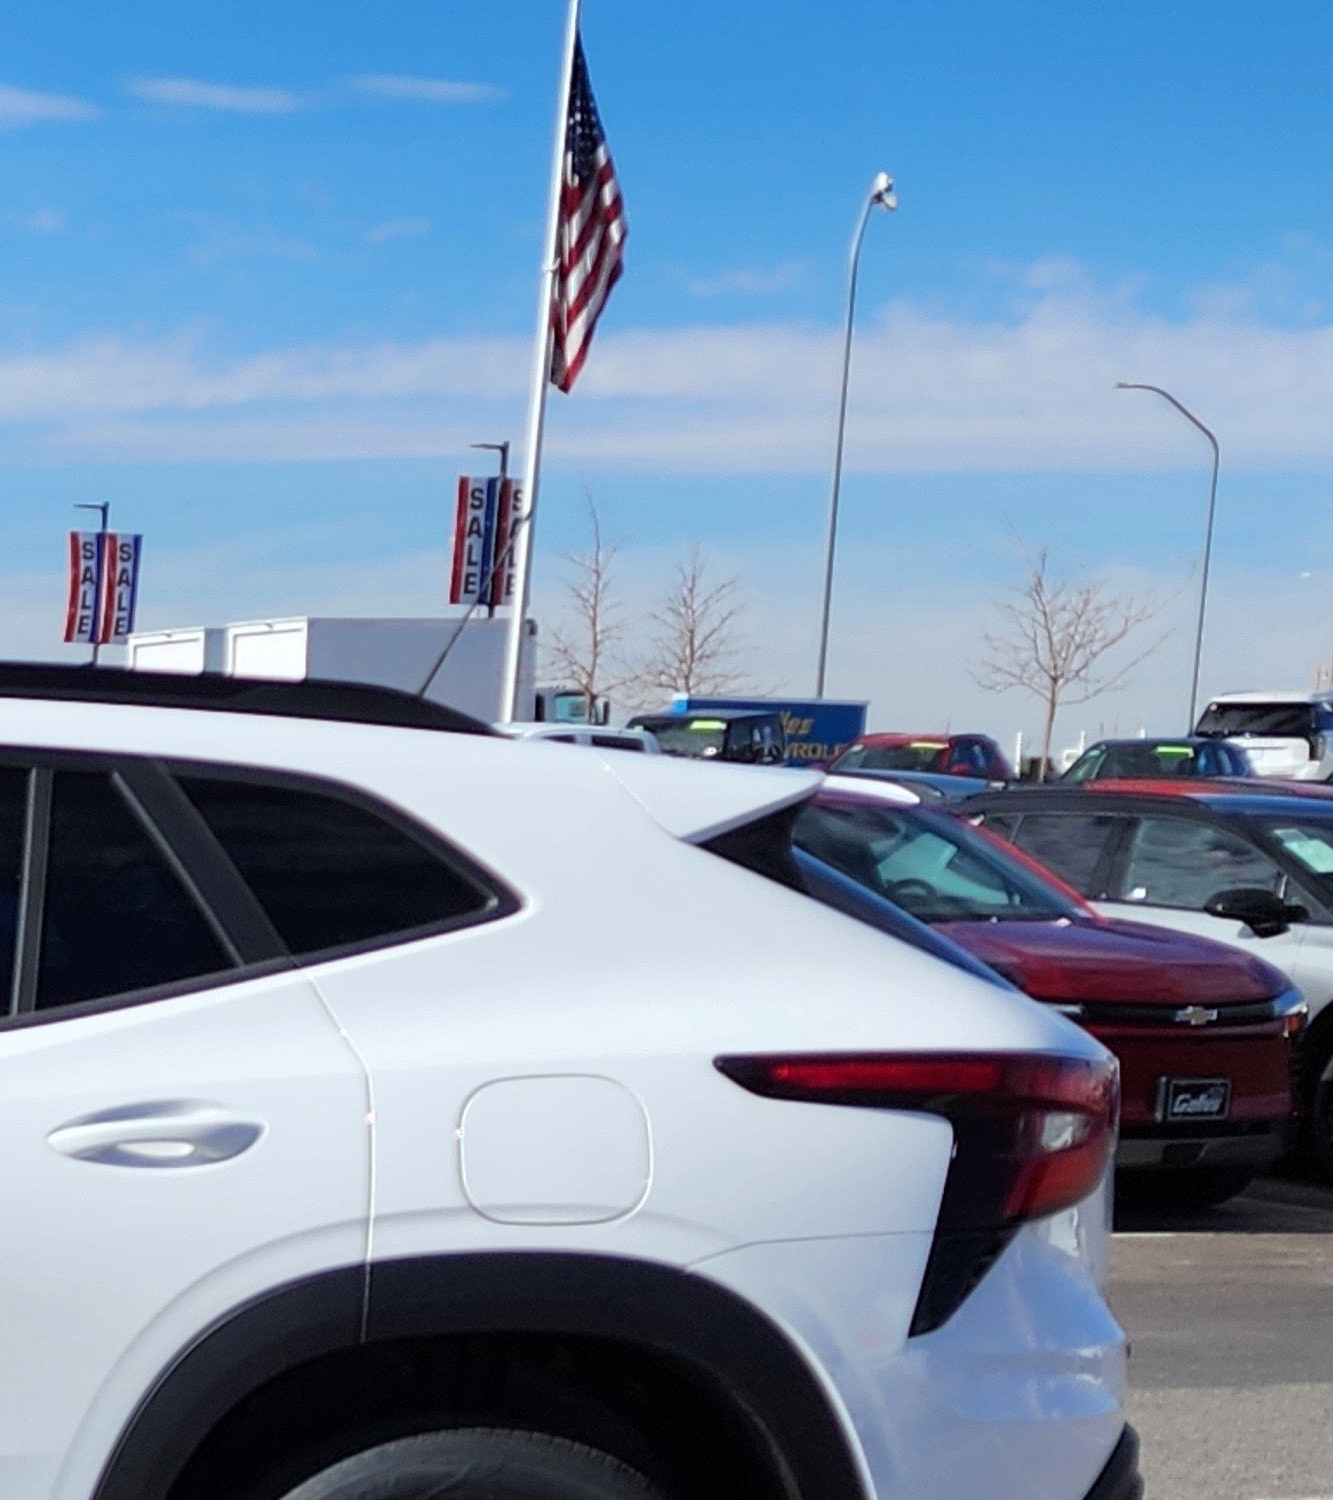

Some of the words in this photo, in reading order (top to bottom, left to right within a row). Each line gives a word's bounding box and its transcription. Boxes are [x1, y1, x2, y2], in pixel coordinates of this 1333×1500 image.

[77, 541, 95, 634] SALE
[464, 488, 484, 594] SALE
[114, 543, 132, 636] SALE
